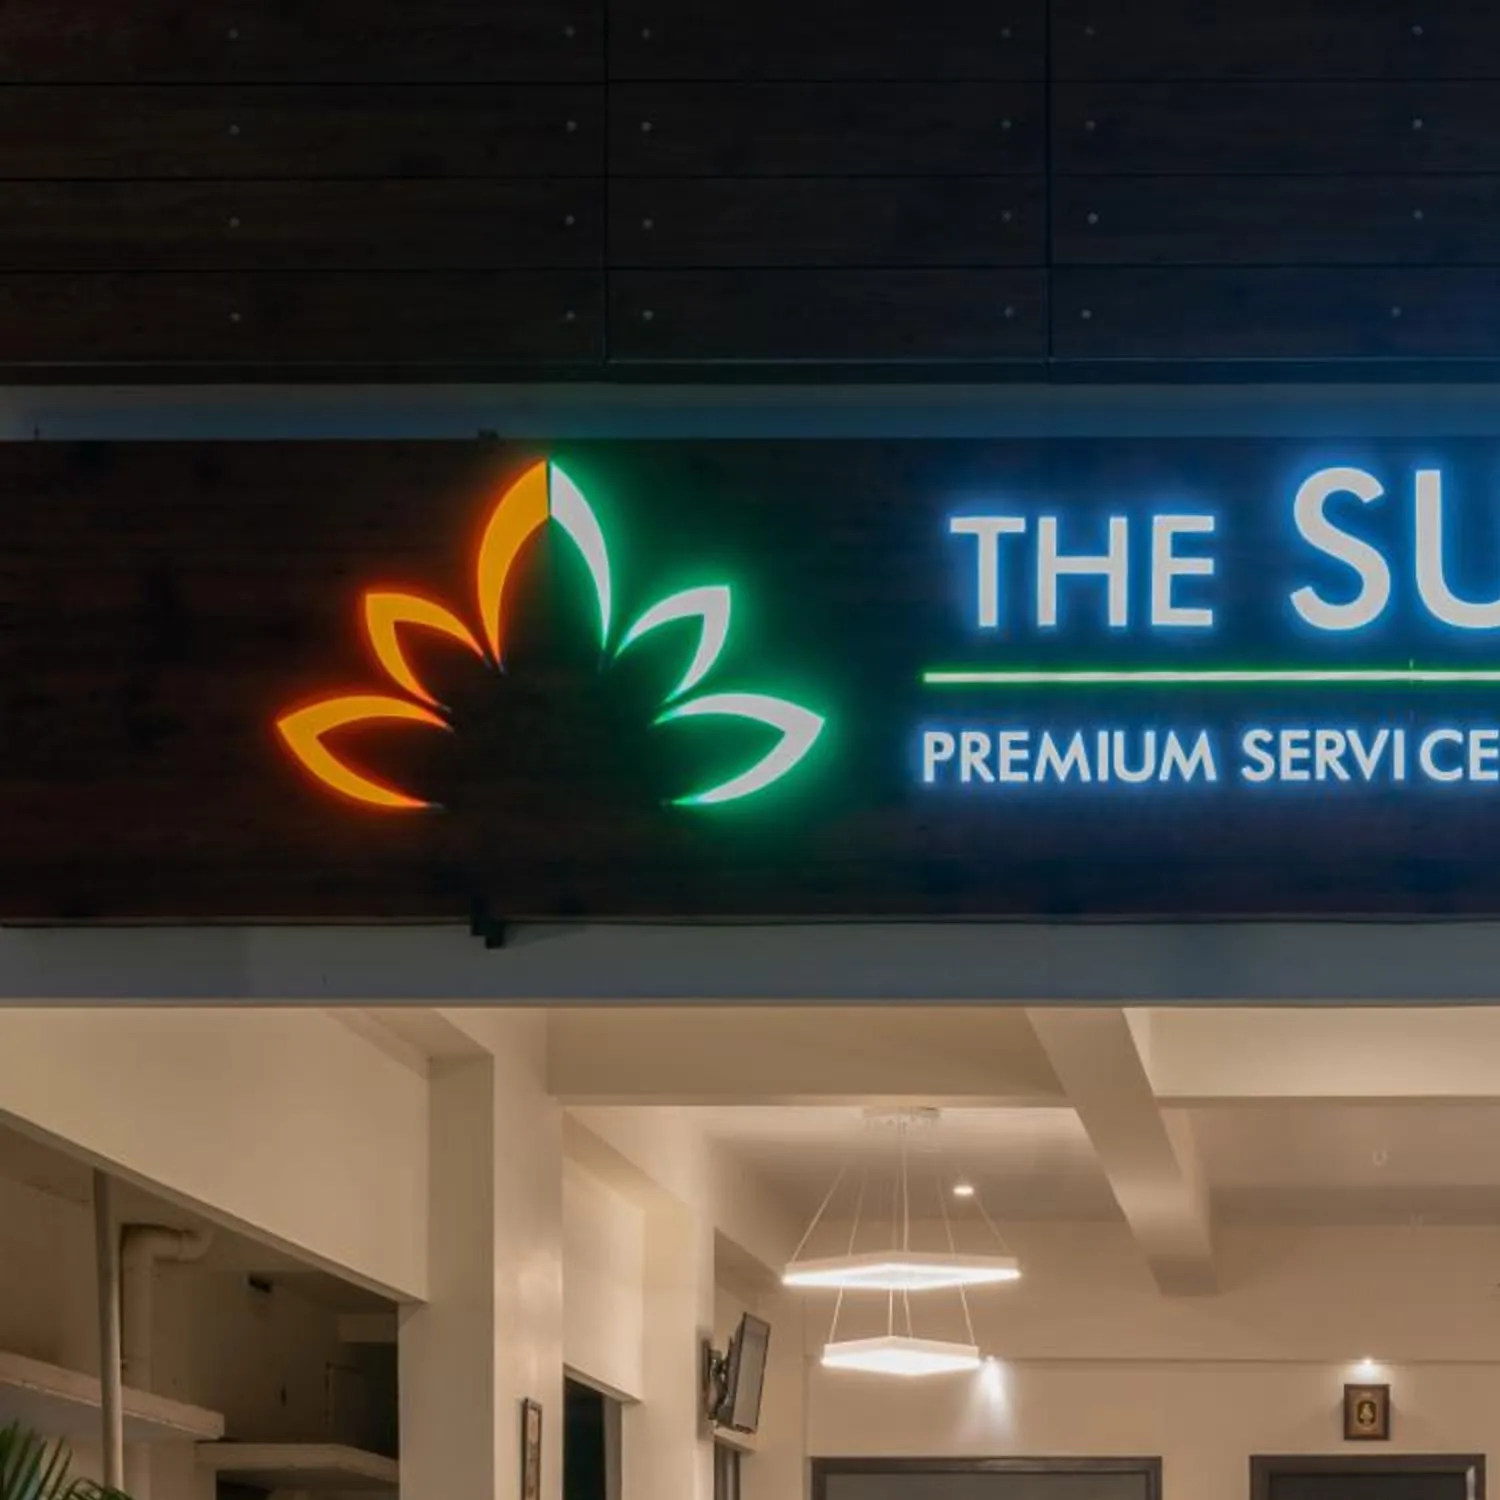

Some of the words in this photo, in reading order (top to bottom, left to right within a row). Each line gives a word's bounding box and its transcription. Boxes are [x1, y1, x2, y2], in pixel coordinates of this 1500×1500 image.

[951, 515, 1215, 627] THE
[923, 731, 1217, 783] PREMIUM
[1242, 729, 1499, 782] SERVICE
